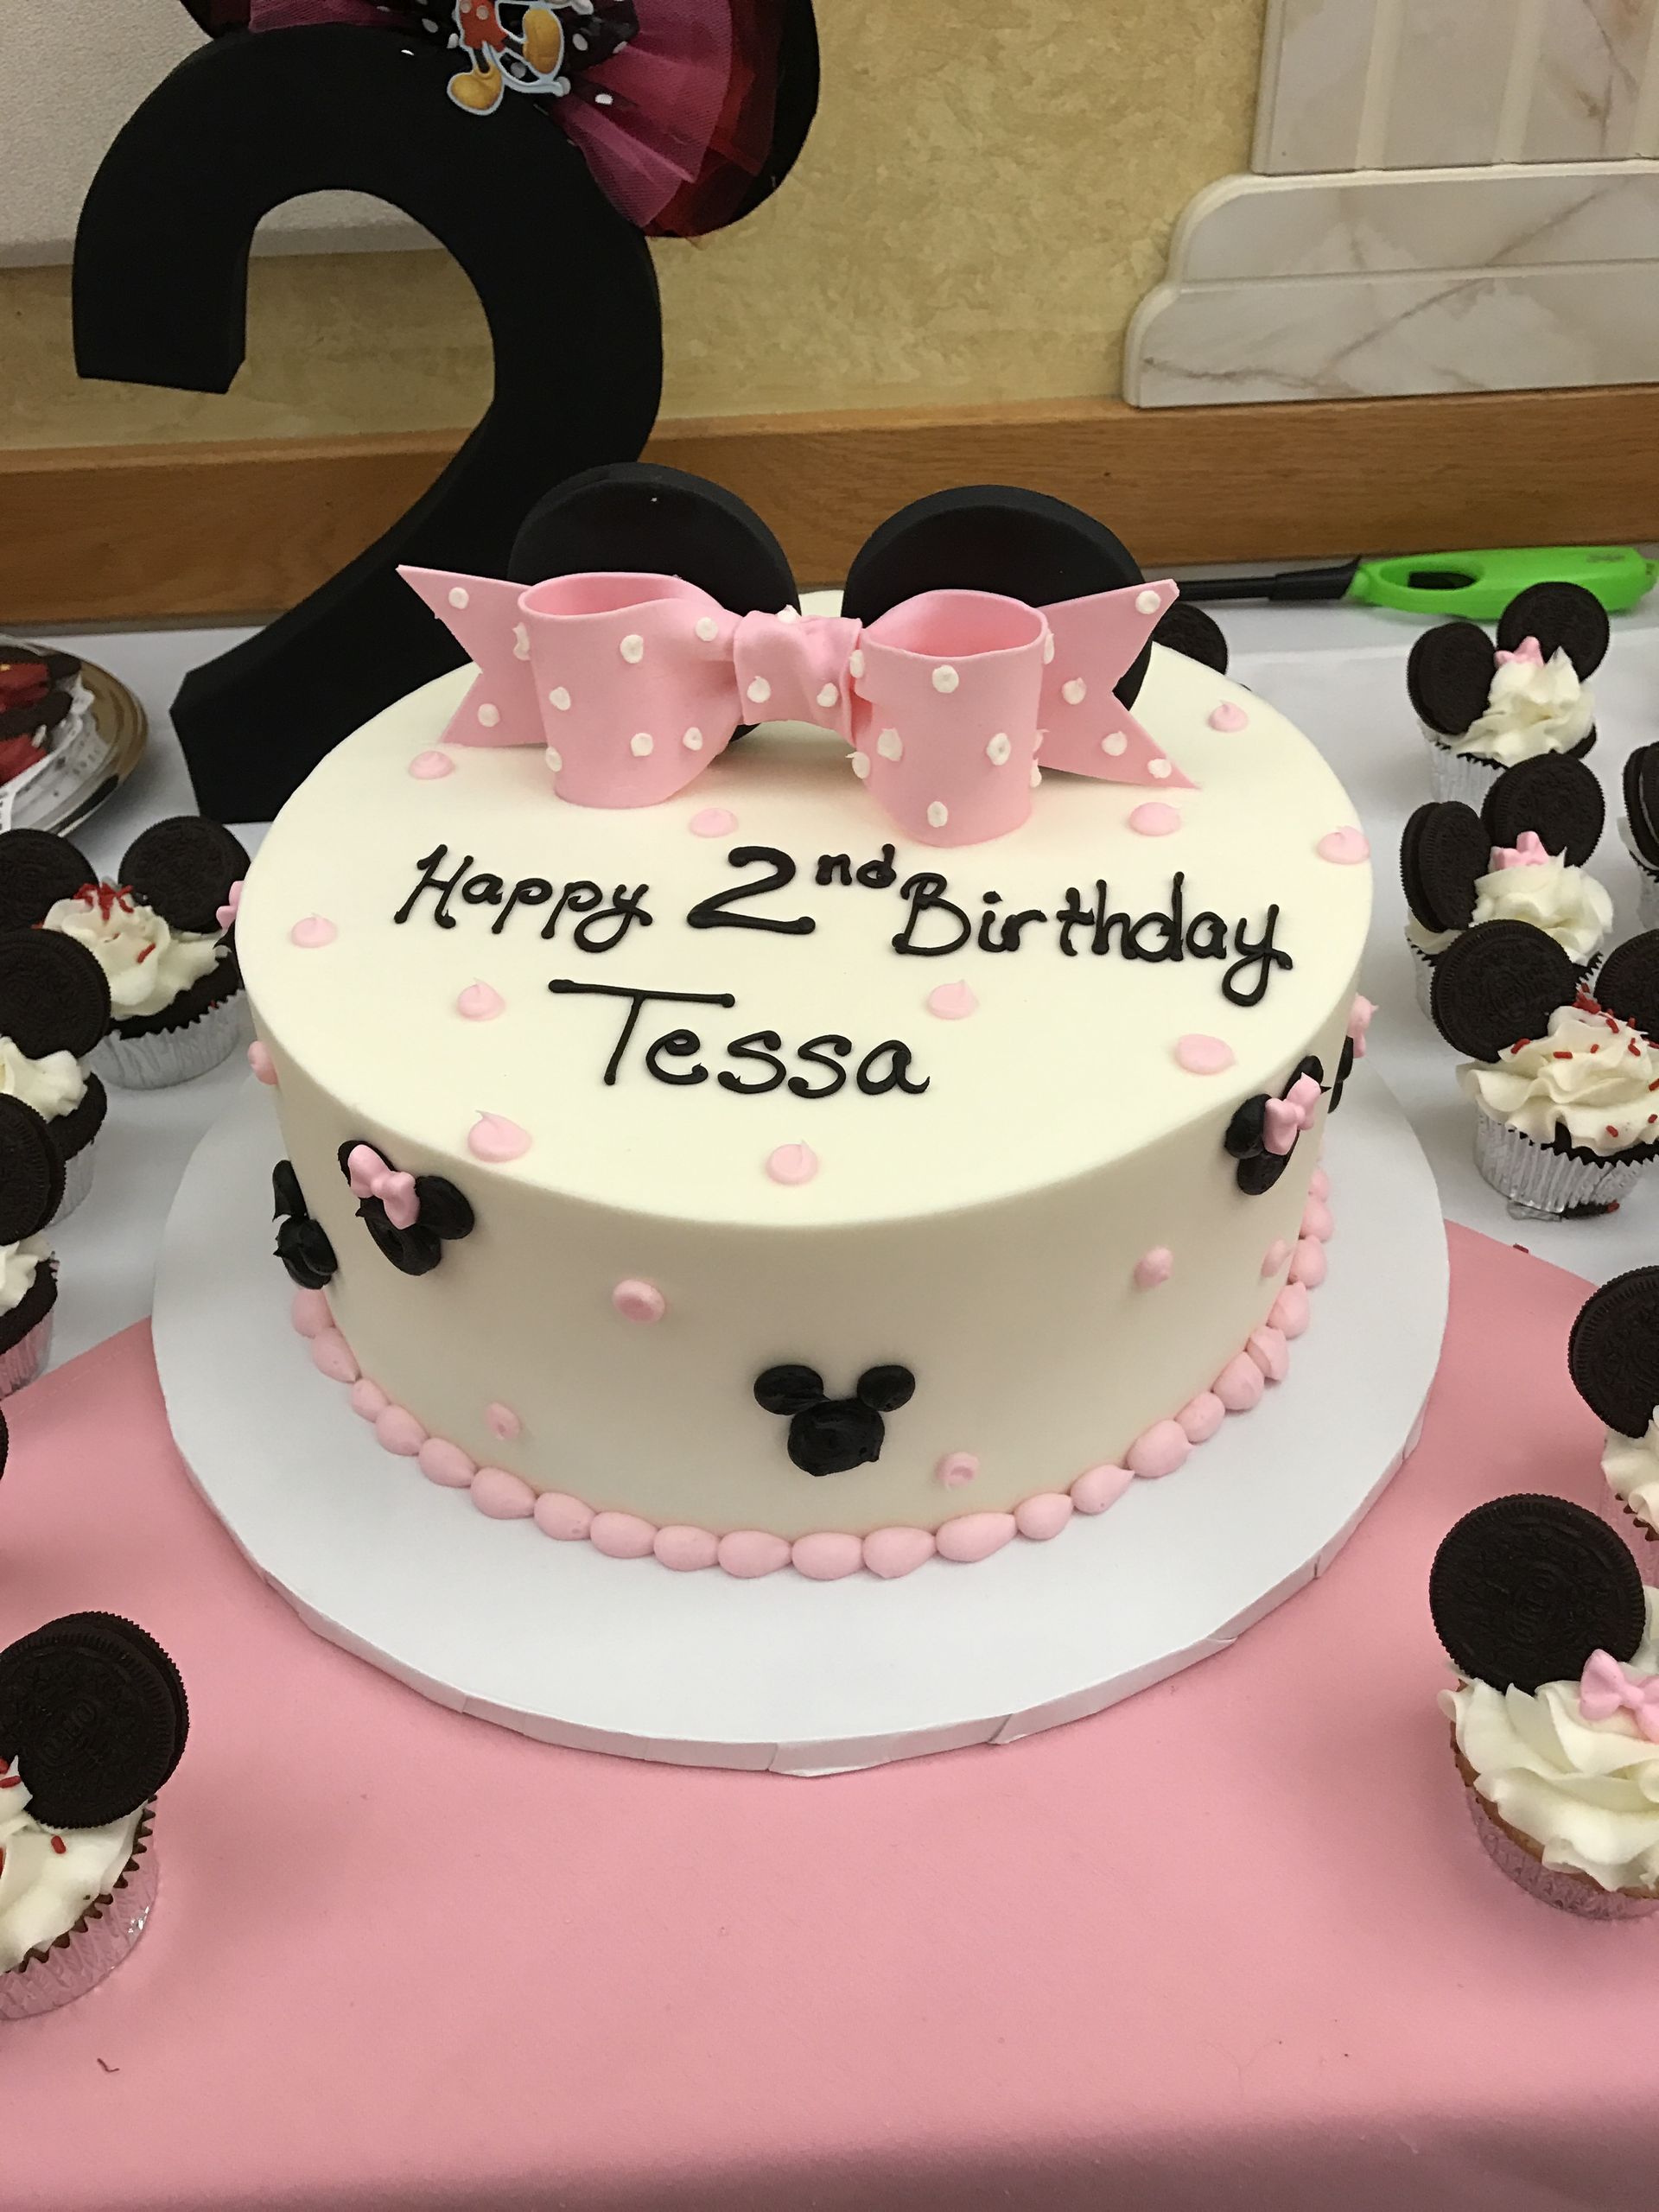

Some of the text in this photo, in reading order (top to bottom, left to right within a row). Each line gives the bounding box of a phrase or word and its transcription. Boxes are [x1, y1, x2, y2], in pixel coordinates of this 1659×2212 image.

[393, 843, 1294, 1007] Happy 2nd Birthday
[548, 979, 931, 1100] Tessa
